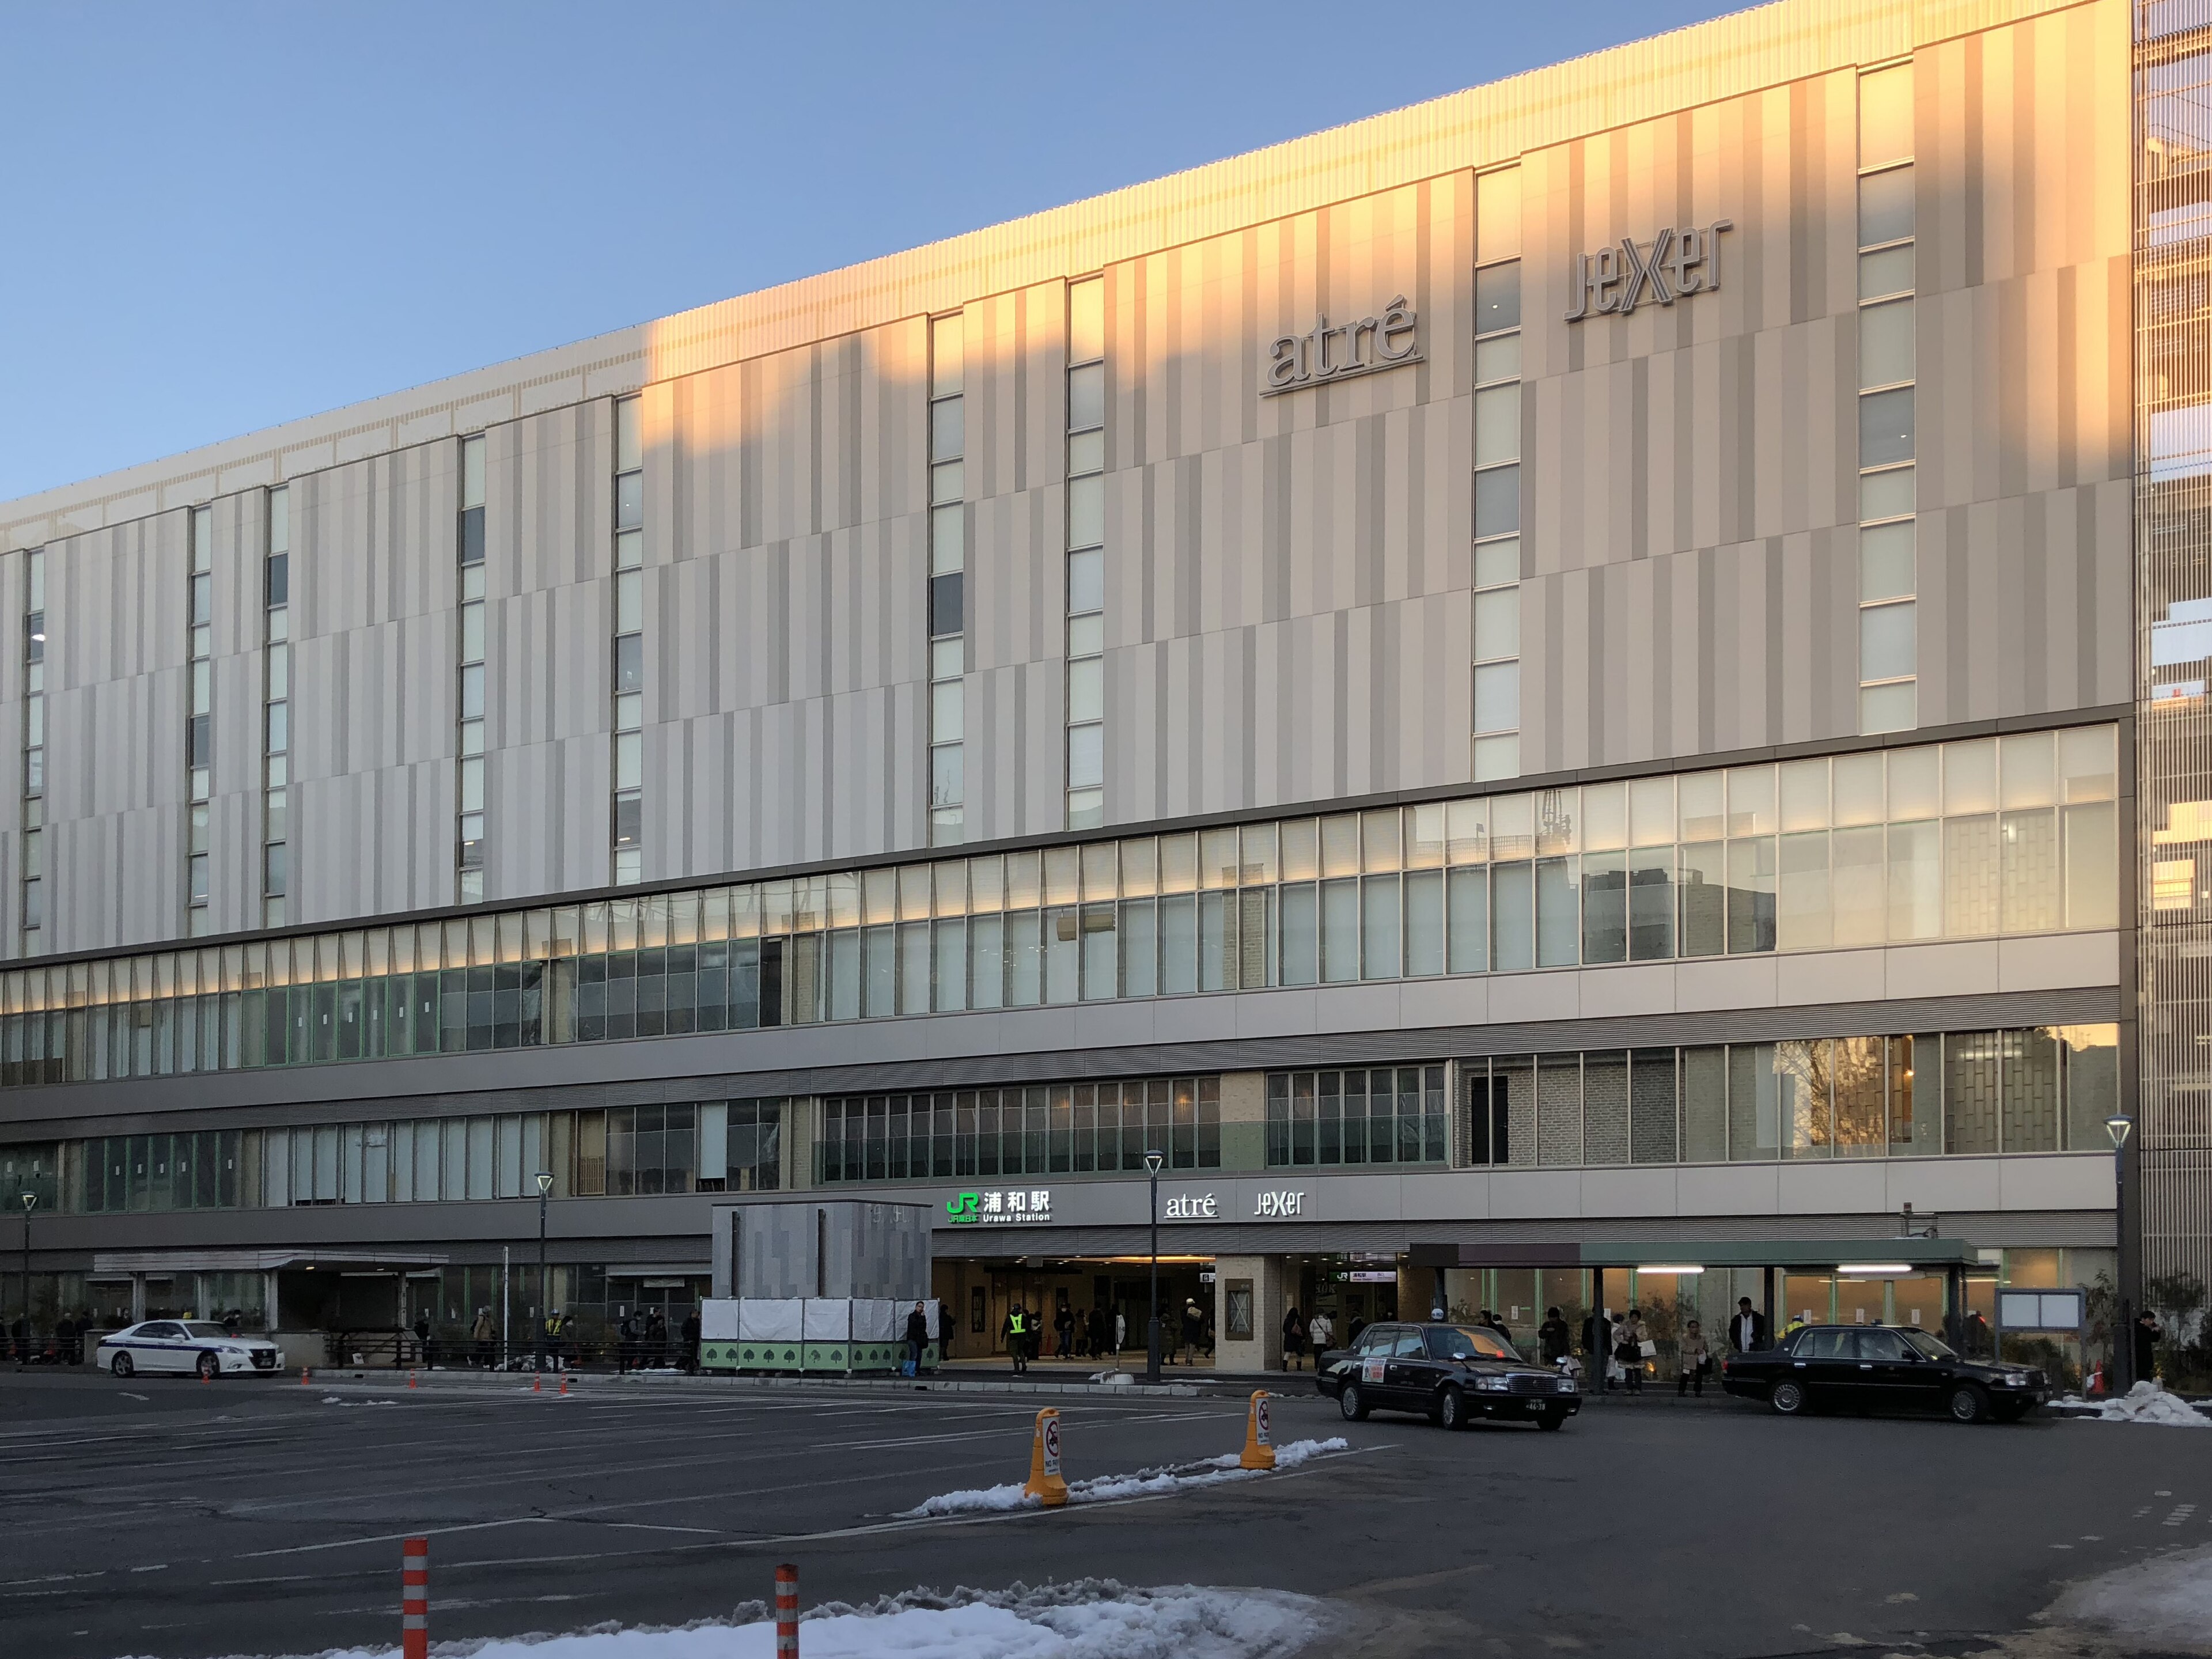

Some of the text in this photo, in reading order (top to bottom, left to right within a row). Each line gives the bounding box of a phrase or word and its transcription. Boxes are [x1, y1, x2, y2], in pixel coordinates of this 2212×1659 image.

[1266, 294, 1418, 387] atré
[946, 1192, 979, 1214] JR
[983, 1191, 1050, 1213] 浦和駅
[1166, 1193, 1217, 1216] atré
[983, 1213, 1050, 1222] Urawa Station
